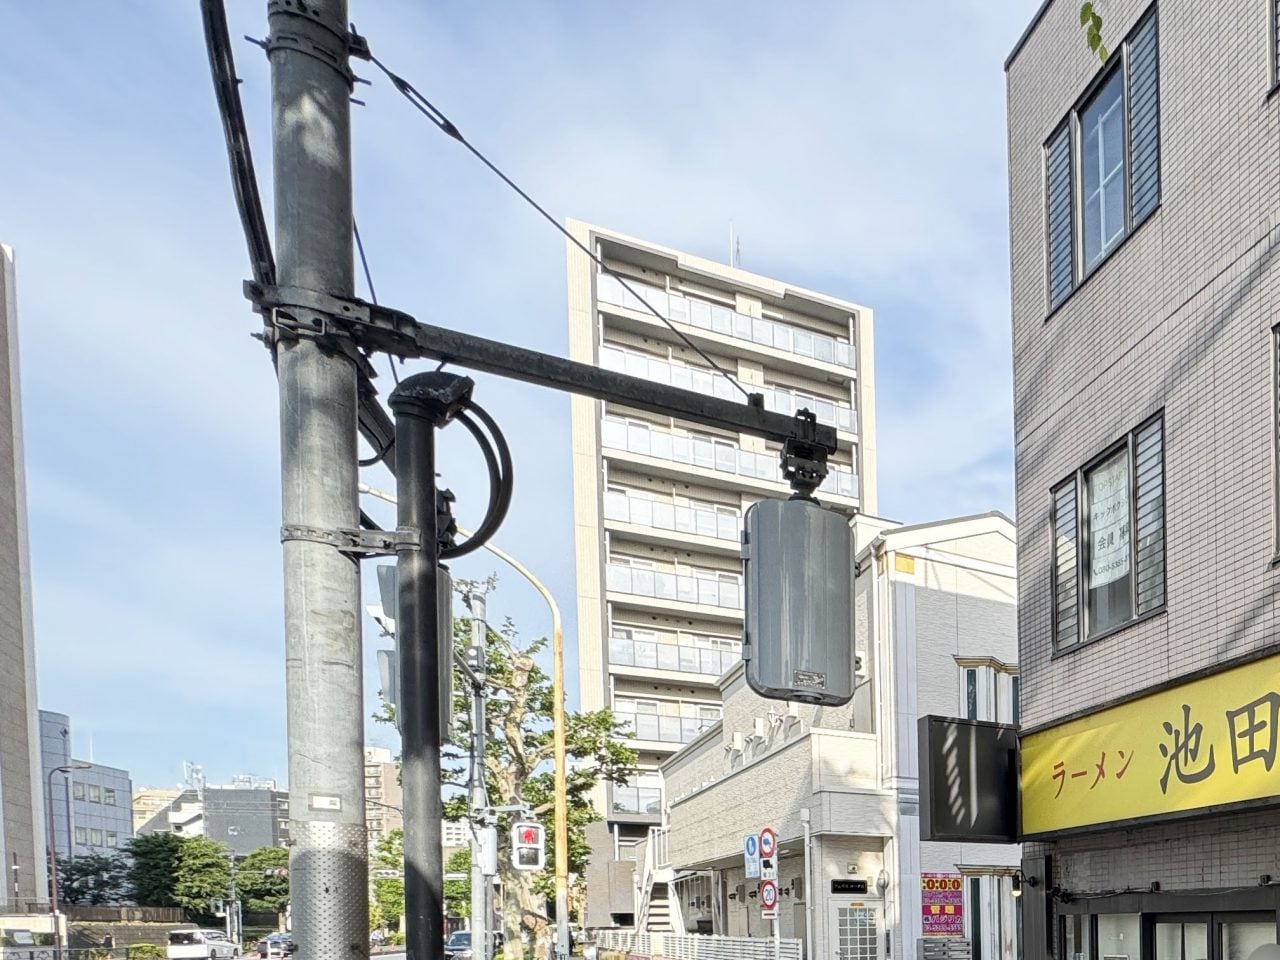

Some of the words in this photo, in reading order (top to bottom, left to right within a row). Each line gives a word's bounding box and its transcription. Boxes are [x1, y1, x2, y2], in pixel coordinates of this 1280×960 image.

[1052, 749, 1134, 798] ラーメン
[765, 888, 773, 901] 20
